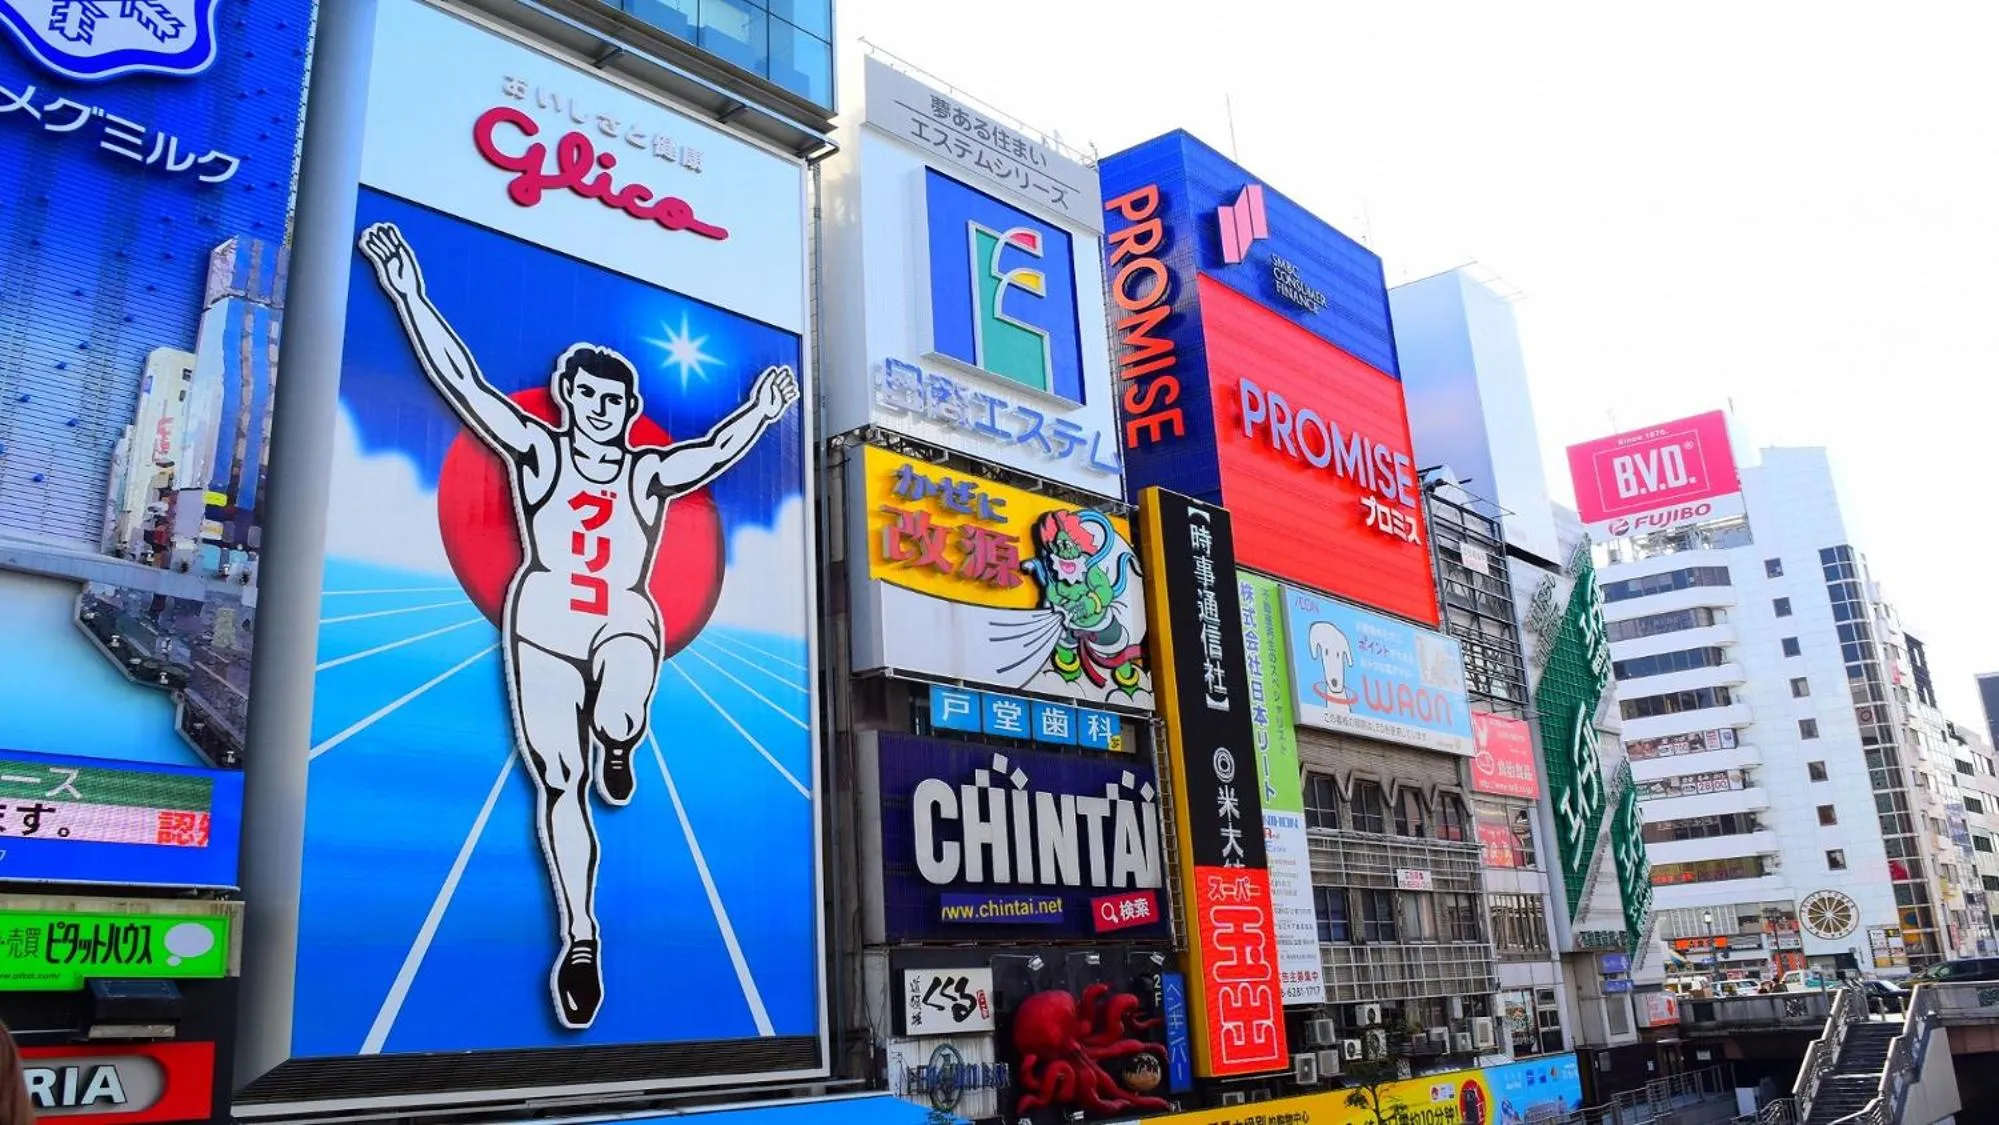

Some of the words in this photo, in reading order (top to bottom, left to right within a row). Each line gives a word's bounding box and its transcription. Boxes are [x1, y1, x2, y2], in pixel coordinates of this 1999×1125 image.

[0, 84, 241, 183] メグミルク
[929, 93, 1048, 169] 夢ある住まい
[473, 105, 730, 241] Glico
[910, 116, 1070, 211] エステムシリーズ
[1104, 183, 1187, 449] PROMISE
[1275, 279, 1321, 316] FINANCE
[1239, 376, 1417, 510] PROMISE
[1612, 444, 1697, 499] B.V.D.
[893, 464, 1008, 523] かぜに
[1360, 496, 1422, 546] プロミス
[1633, 503, 1712, 530] FUJIBO
[567, 490, 617, 617] グリコ
[881, 504, 1024, 589] 改源
[940, 692, 1113, 743] 戸堂歯科
[913, 753, 1162, 889] CHINTAI
[1120, 898, 1150, 921] 検索
[1208, 876, 1262, 901] スーパー
[45, 921, 153, 967] ピタットハウス
[922, 976, 978, 1023] くくる
[1153, 974, 1163, 1008] 2F
